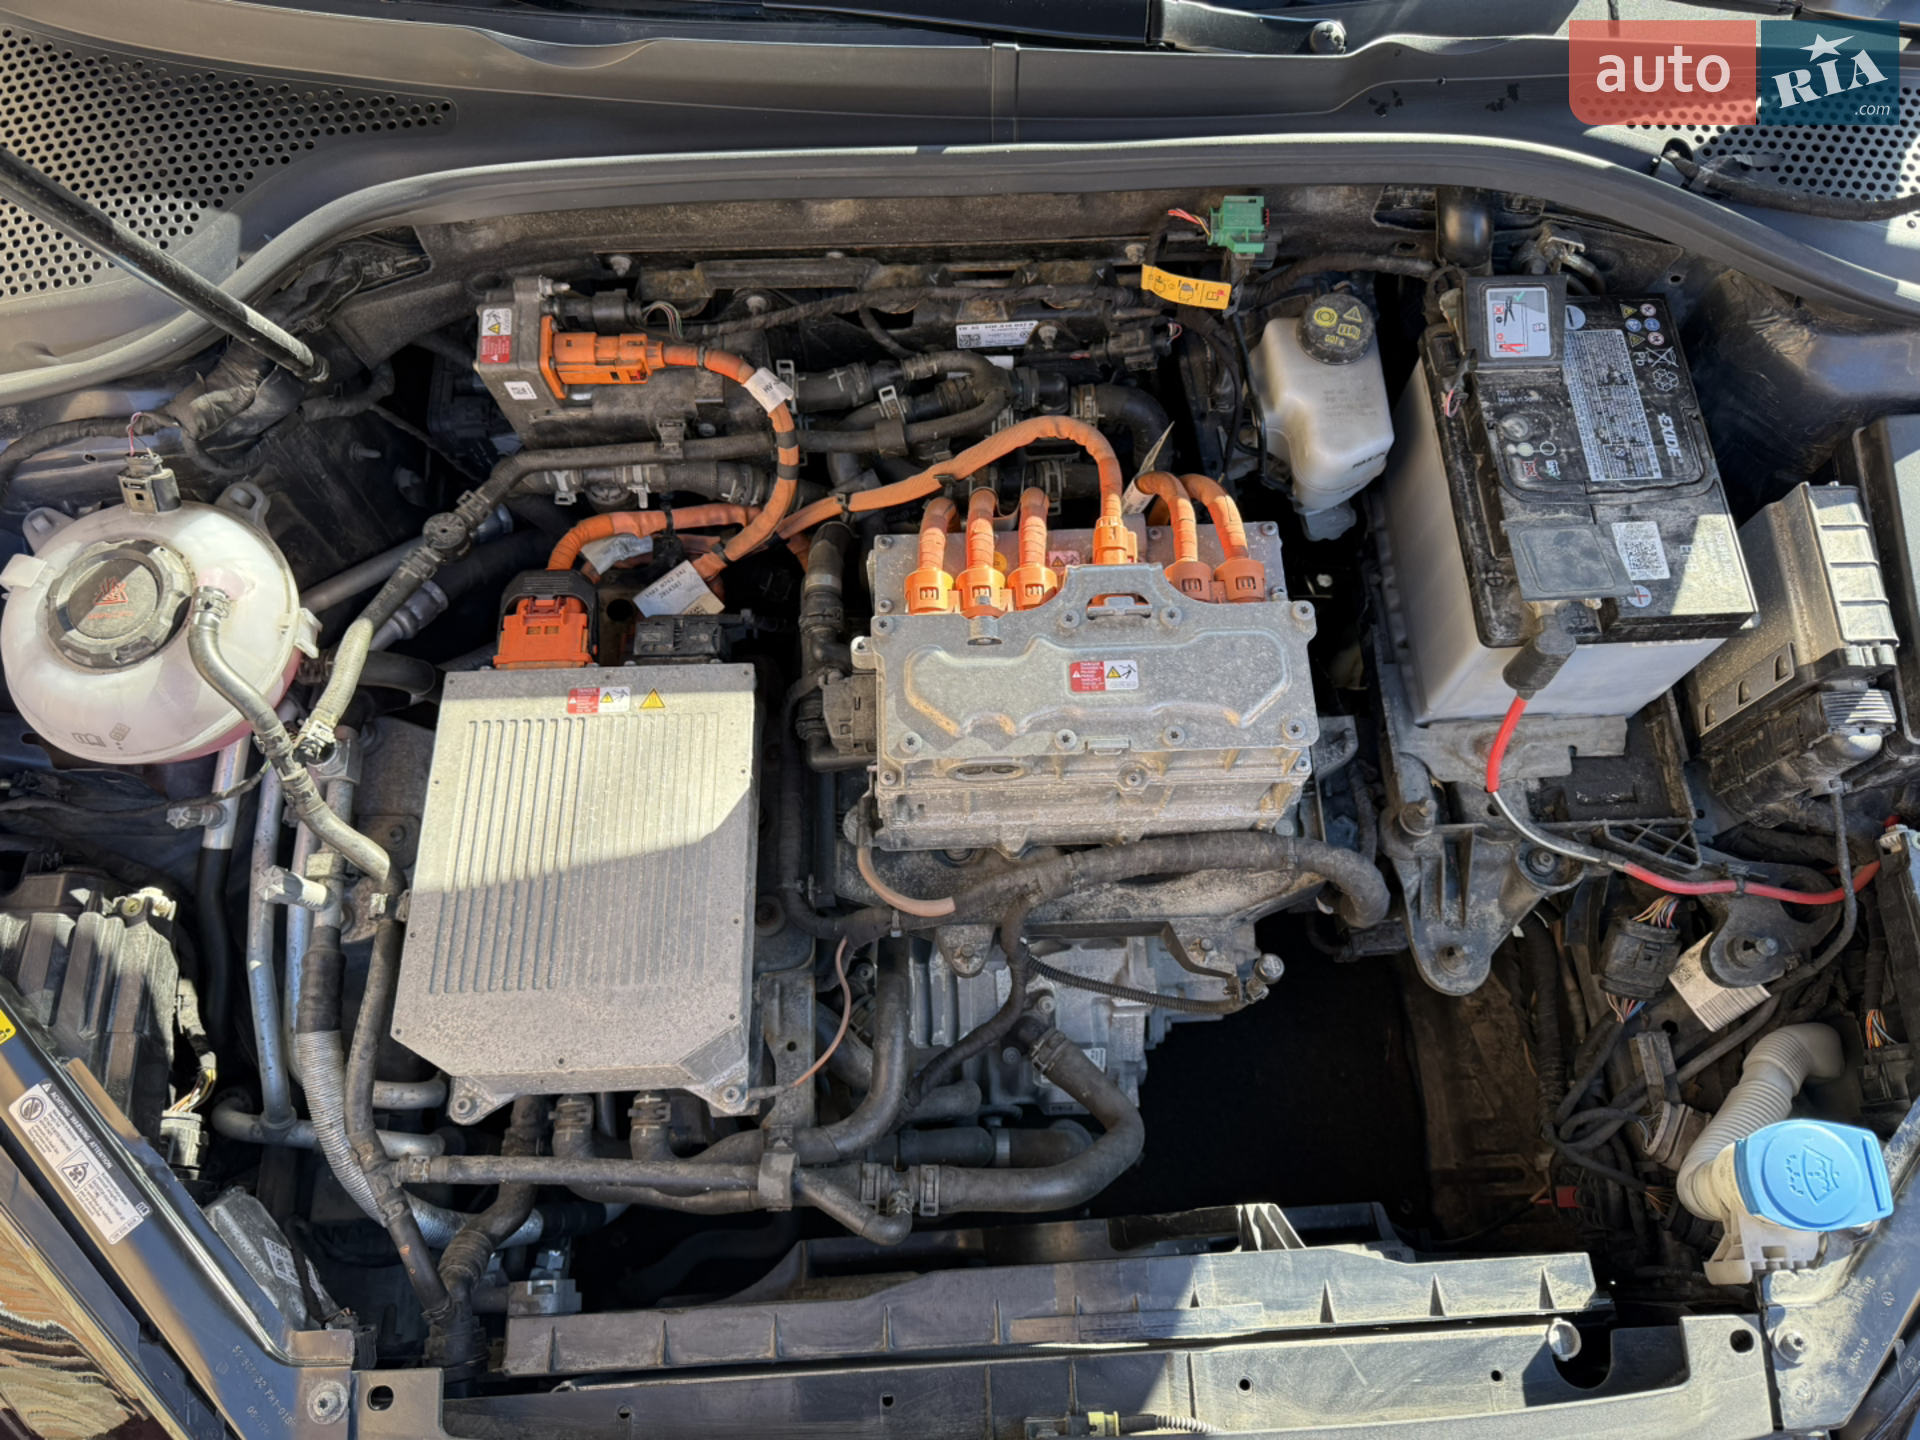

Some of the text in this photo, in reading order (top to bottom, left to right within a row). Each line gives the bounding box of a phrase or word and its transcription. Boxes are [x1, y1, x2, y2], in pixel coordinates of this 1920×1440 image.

[1633, 350, 1647, 367] Pb
[1659, 414, 1681, 458] EXIDE
[1680, 545, 1699, 572] EFB
[50, 1091, 72, 1118] ACHTUNG
[69, 1114, 91, 1143] WARNING
[89, 1137, 113, 1169] ATTENTION
